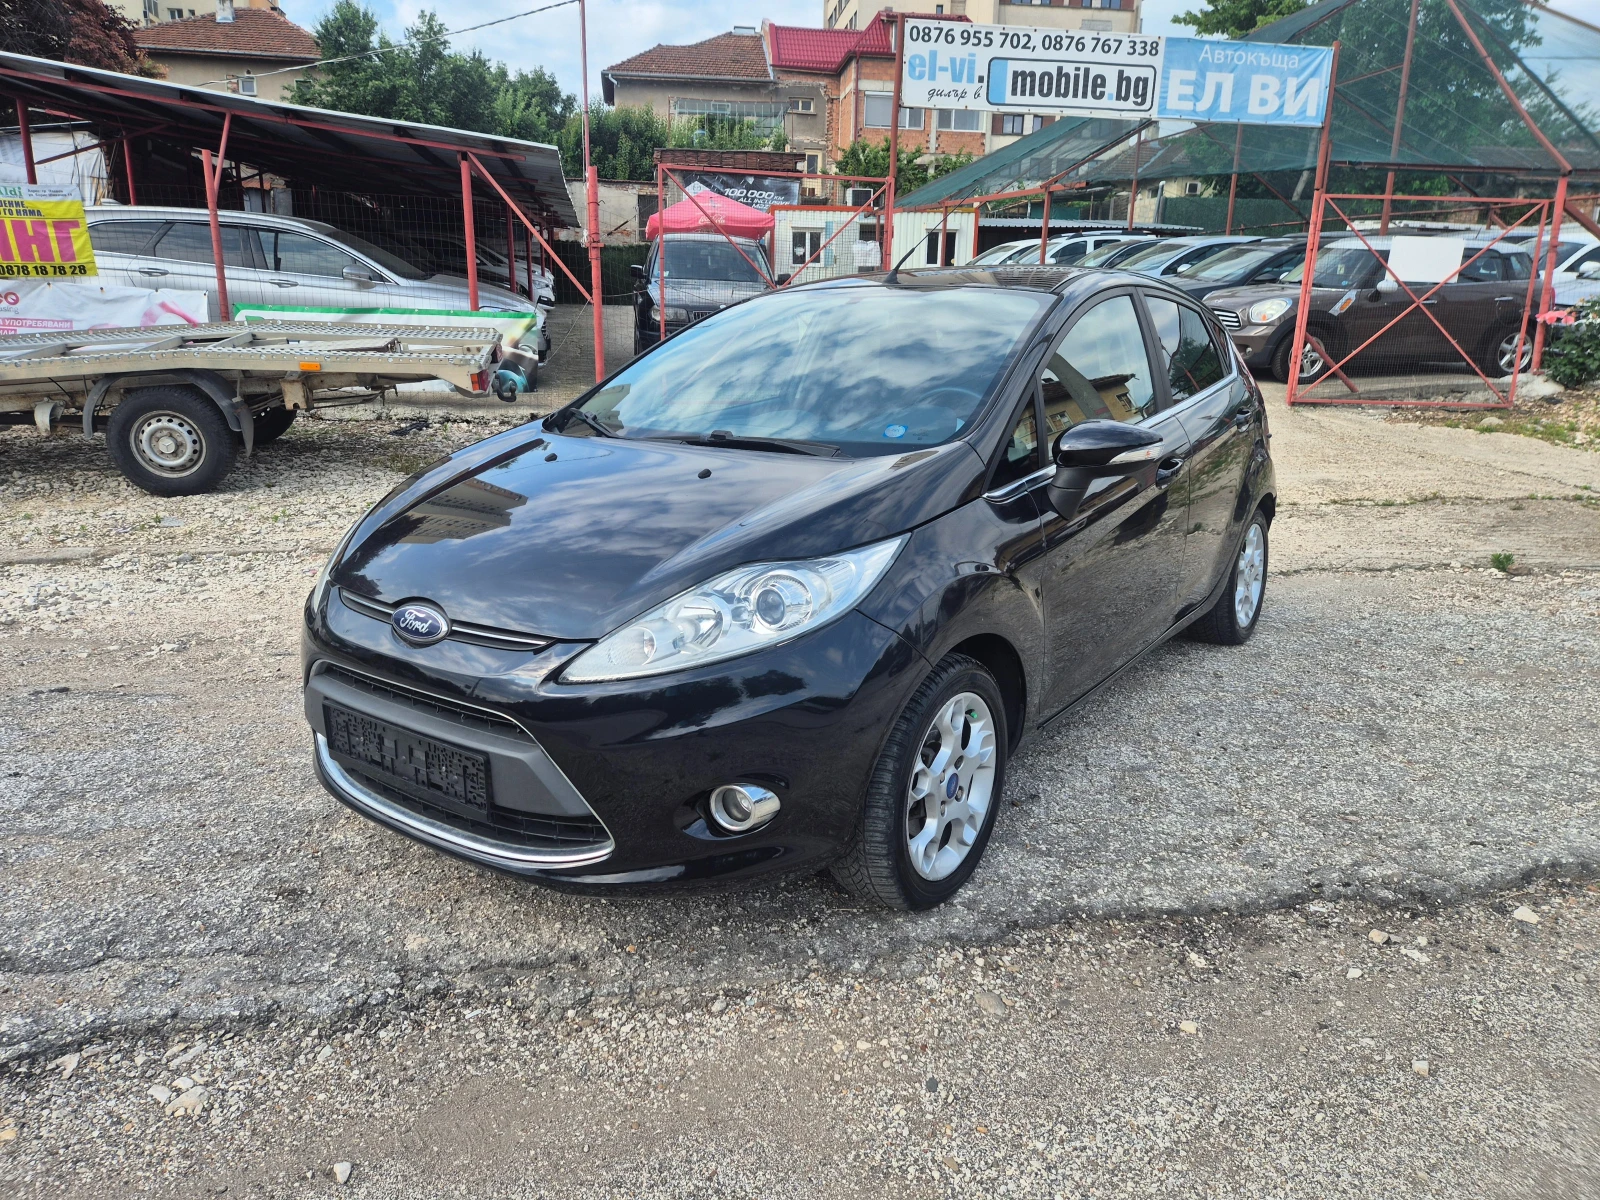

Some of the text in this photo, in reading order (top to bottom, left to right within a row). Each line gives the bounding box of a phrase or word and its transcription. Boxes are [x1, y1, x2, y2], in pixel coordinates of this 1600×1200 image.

[909, 25, 1160, 57] 0876 955 702, 0876 767 338
[1199, 44, 1300, 71] Автокъща
[1010, 65, 1150, 107] mobile.bg
[1166, 69, 1321, 117] ЕЛ ВИ
[0, 186, 23, 197] ldi
[724, 188, 746, 197] 100
[747, 190, 775, 199] 000
[32, 265, 48, 276] 18
[50, 265, 67, 276] 78
[69, 265, 87, 275] 28
[5, 319, 71, 328] УПОТРЕБЯВАНИ
[400, 609, 432, 634] Ford
